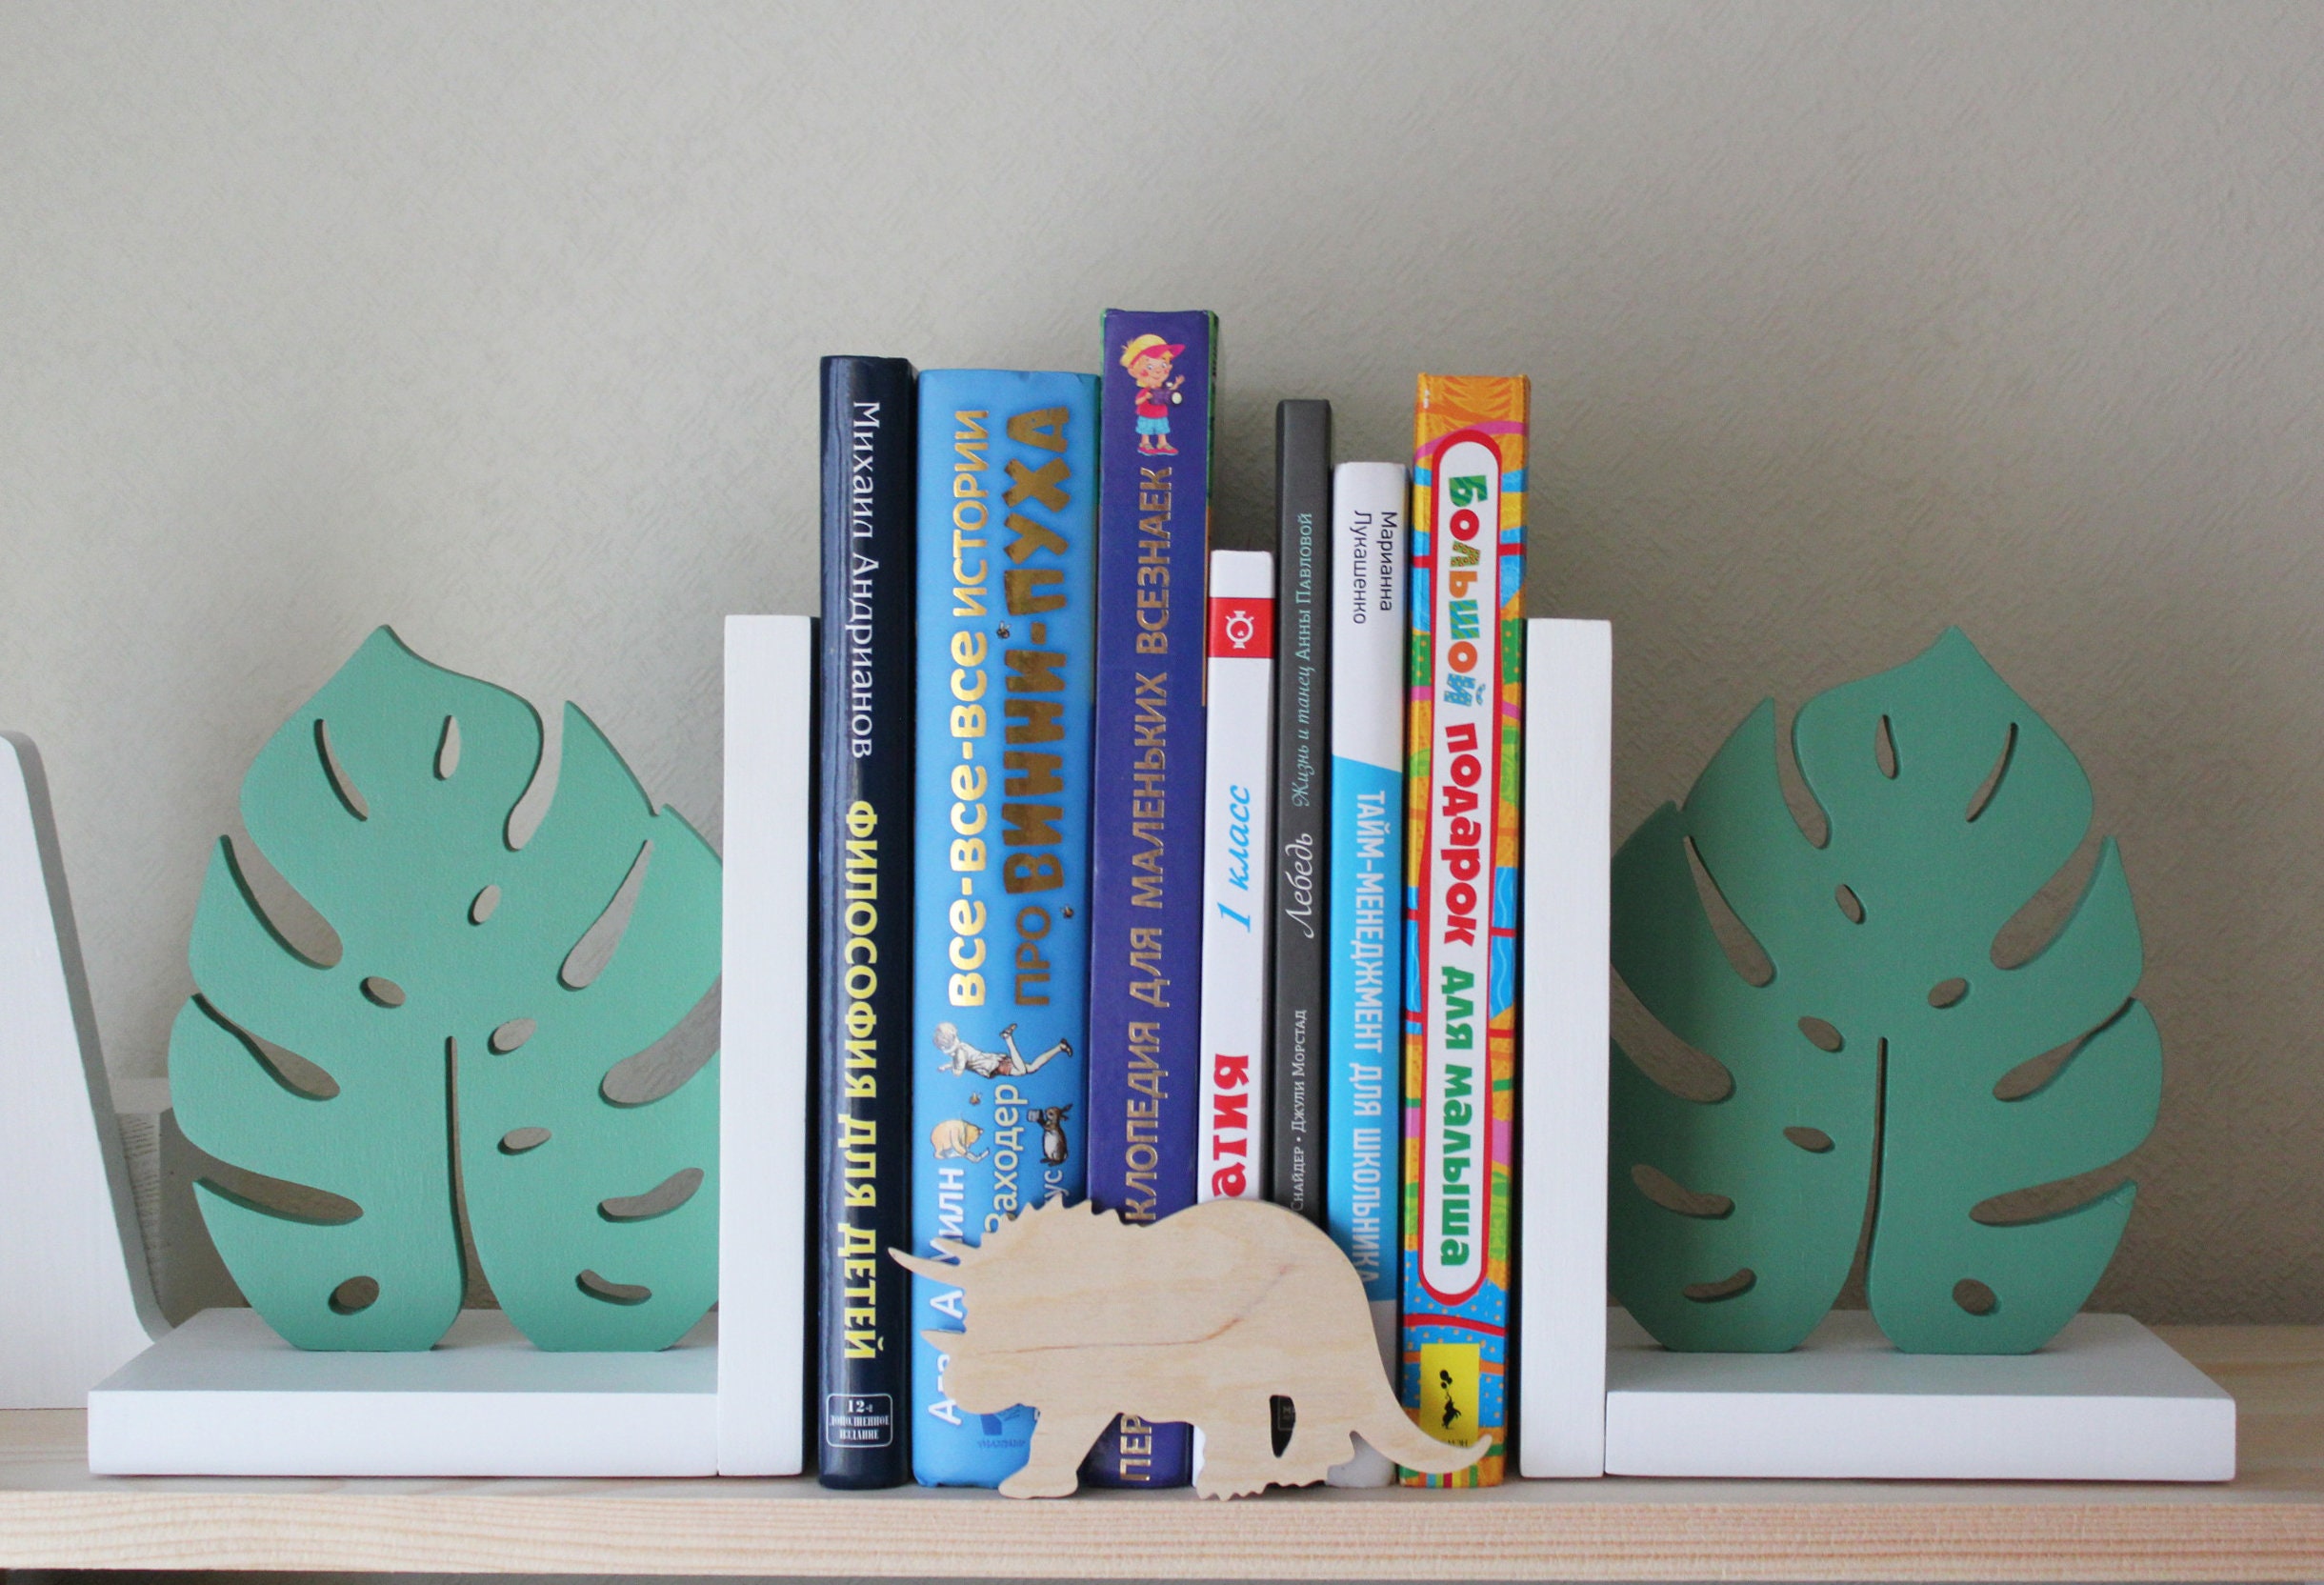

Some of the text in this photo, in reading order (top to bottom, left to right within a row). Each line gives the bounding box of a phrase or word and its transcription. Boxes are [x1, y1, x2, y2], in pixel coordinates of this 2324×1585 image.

[845, 401, 880, 759] Михаил Андрианов
[952, 410, 990, 617] ИСТОРИИ
[1135, 467, 1172, 654] ВСЕЗНАЕК
[1350, 510, 1372, 625] Лукашенко
[1377, 512, 1398, 612] Марианна
[1002, 406, 1071, 1006] ПРО ВИННИ-ПУХА
[1131, 672, 1168, 909] МАЛЕНЬКИХ
[1216, 785, 1252, 933] 1 класс
[1285, 833, 1315, 938] Лебедь
[1350, 791, 1391, 1053] ТАЙМ-МЕНЕДЖМЕНТ
[1130, 928, 1170, 1008] ДЛЯ
[837, 800, 885, 1359] ФИЛОСОФИЯ ДЛЯ ДЕТЕЙ
[1349, 1062, 1383, 1116] ДЛЯ
